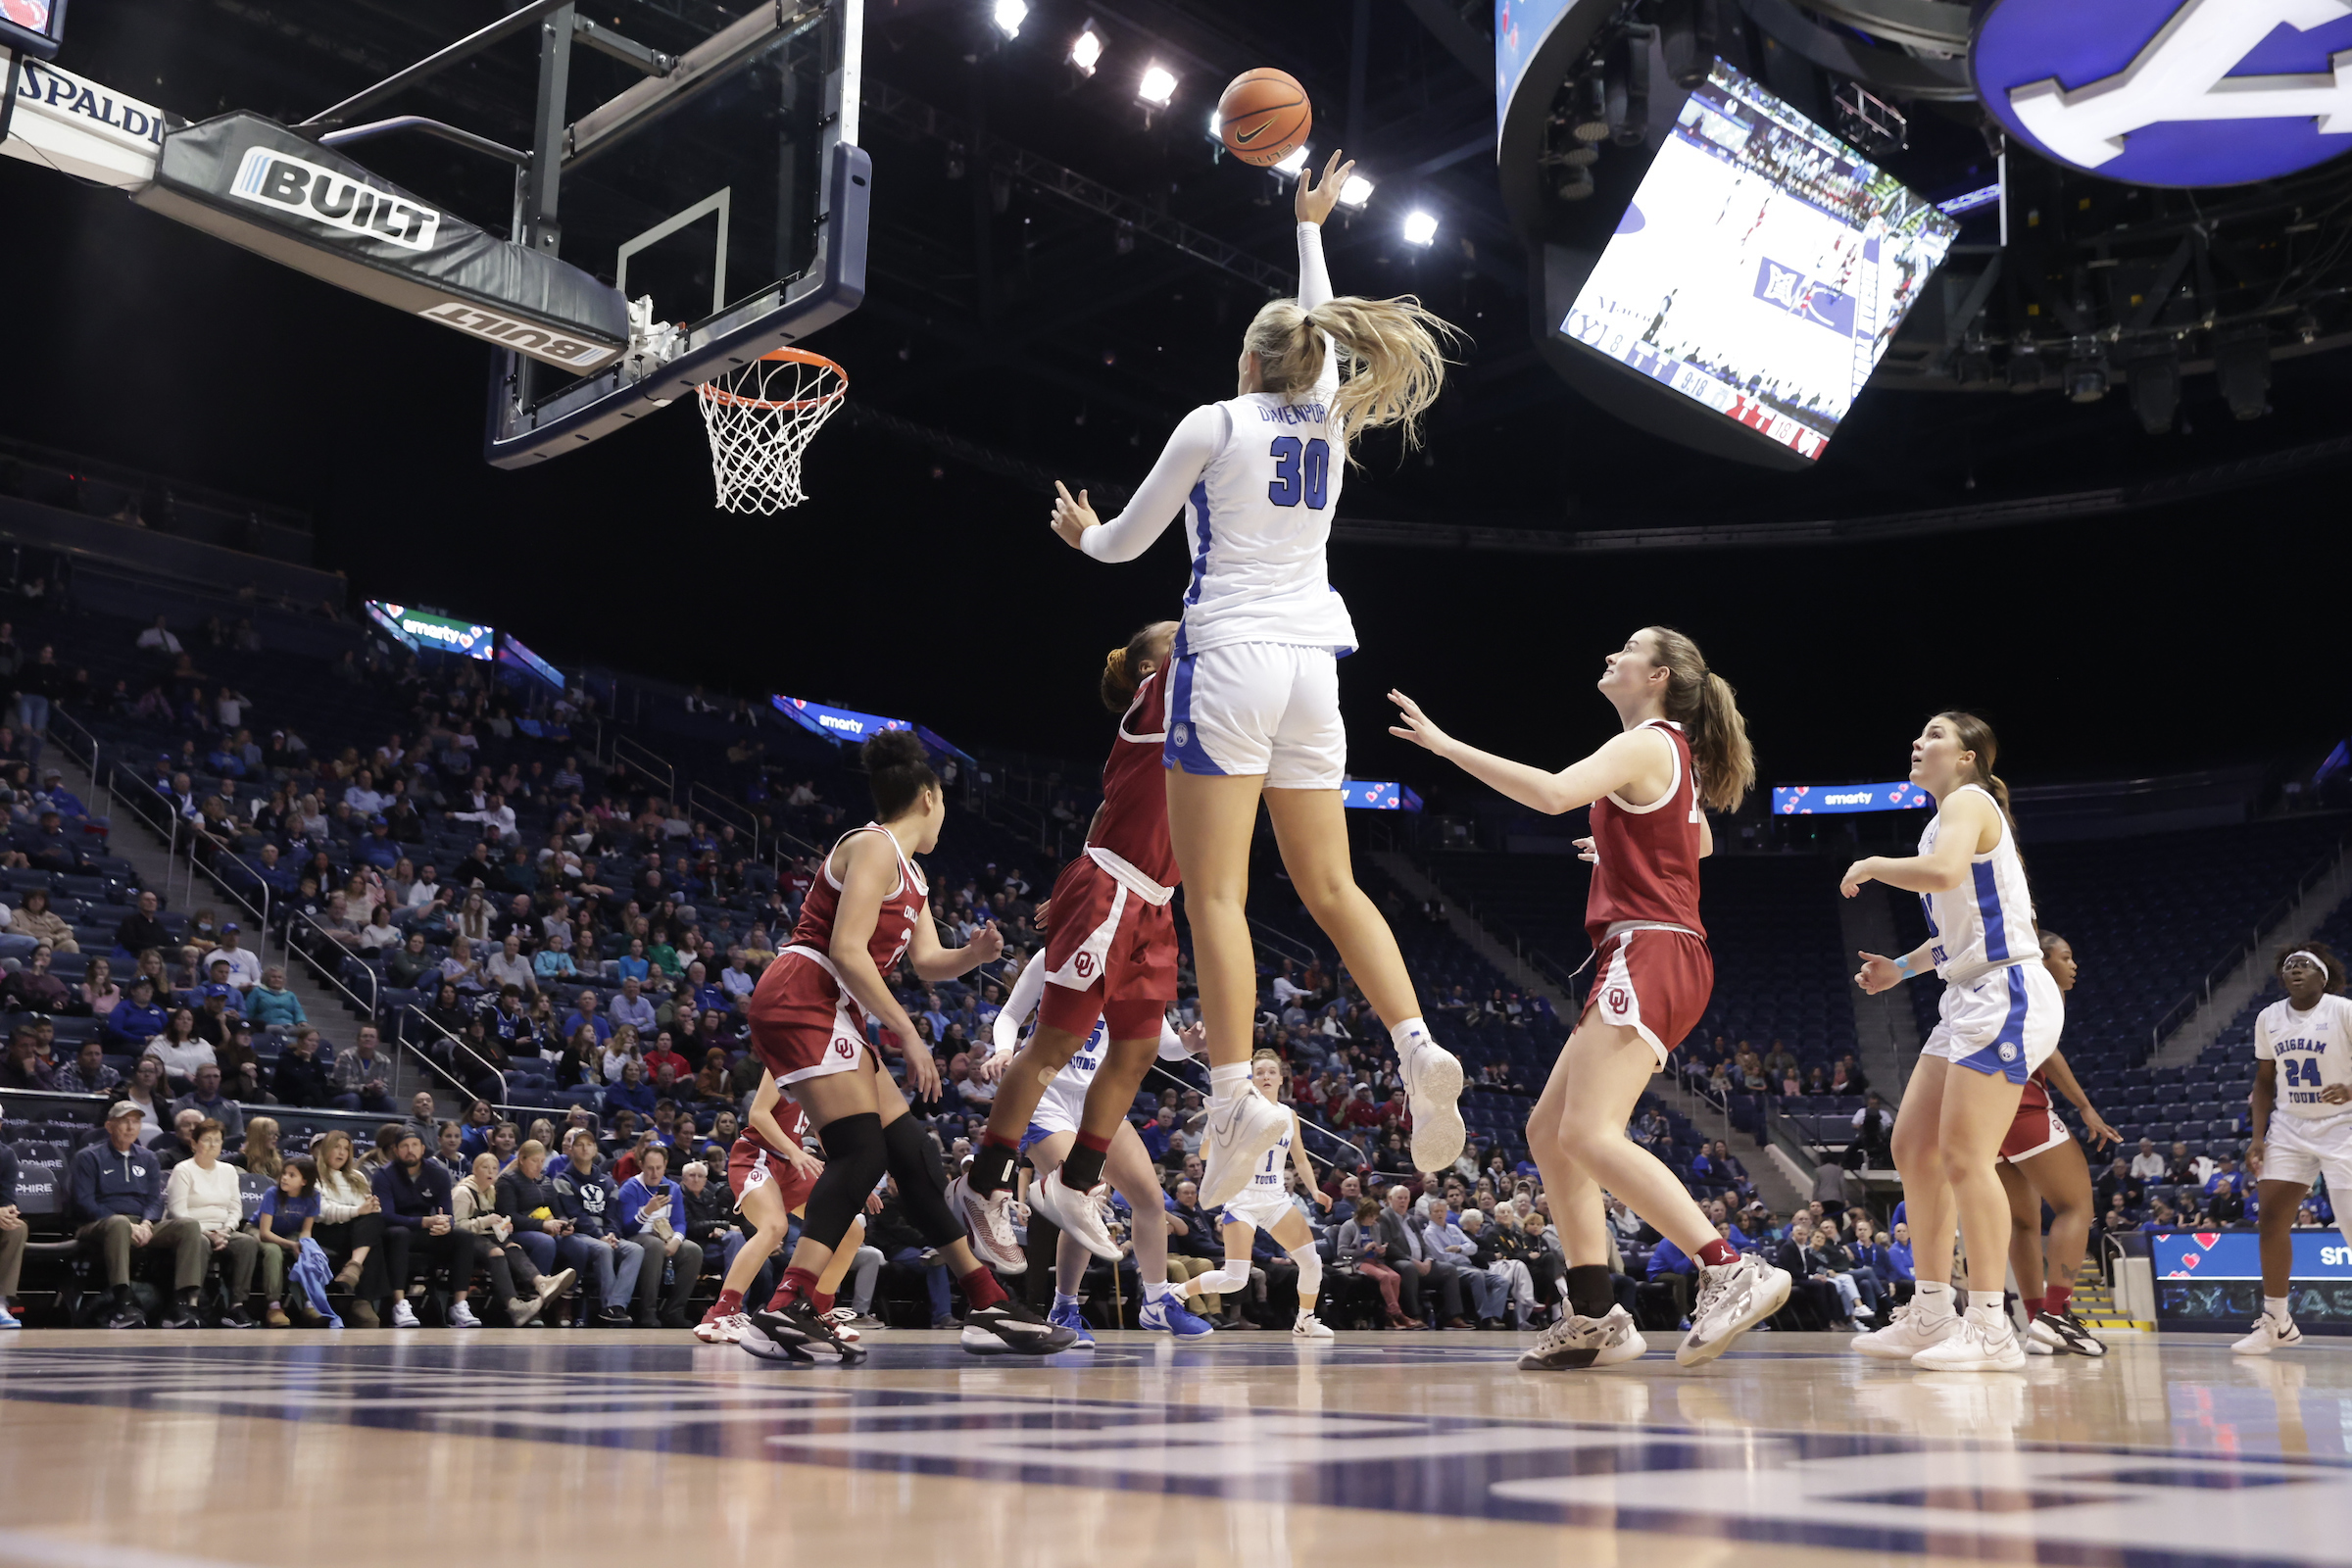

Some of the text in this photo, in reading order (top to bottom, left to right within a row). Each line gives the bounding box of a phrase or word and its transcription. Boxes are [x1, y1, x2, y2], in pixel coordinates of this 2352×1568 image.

[1245, 141, 1293, 165] ELITE
[260, 159, 435, 243] BUILT
[427, 308, 592, 360] BUILT
[1268, 436, 1330, 511] 30
[402, 618, 461, 644] smarty
[819, 714, 863, 734] smarty
[1824, 792, 1872, 806] smarty
[1074, 951, 1095, 978] OU
[1608, 989, 1629, 1014] OU
[835, 1037, 854, 1059] OU
[2274, 1038, 2327, 1056] BRIGHAM
[2284, 1057, 2323, 1087] 24
[1265, 1150, 1274, 1172] 1
[1254, 1174, 1277, 1185] YOUNG
